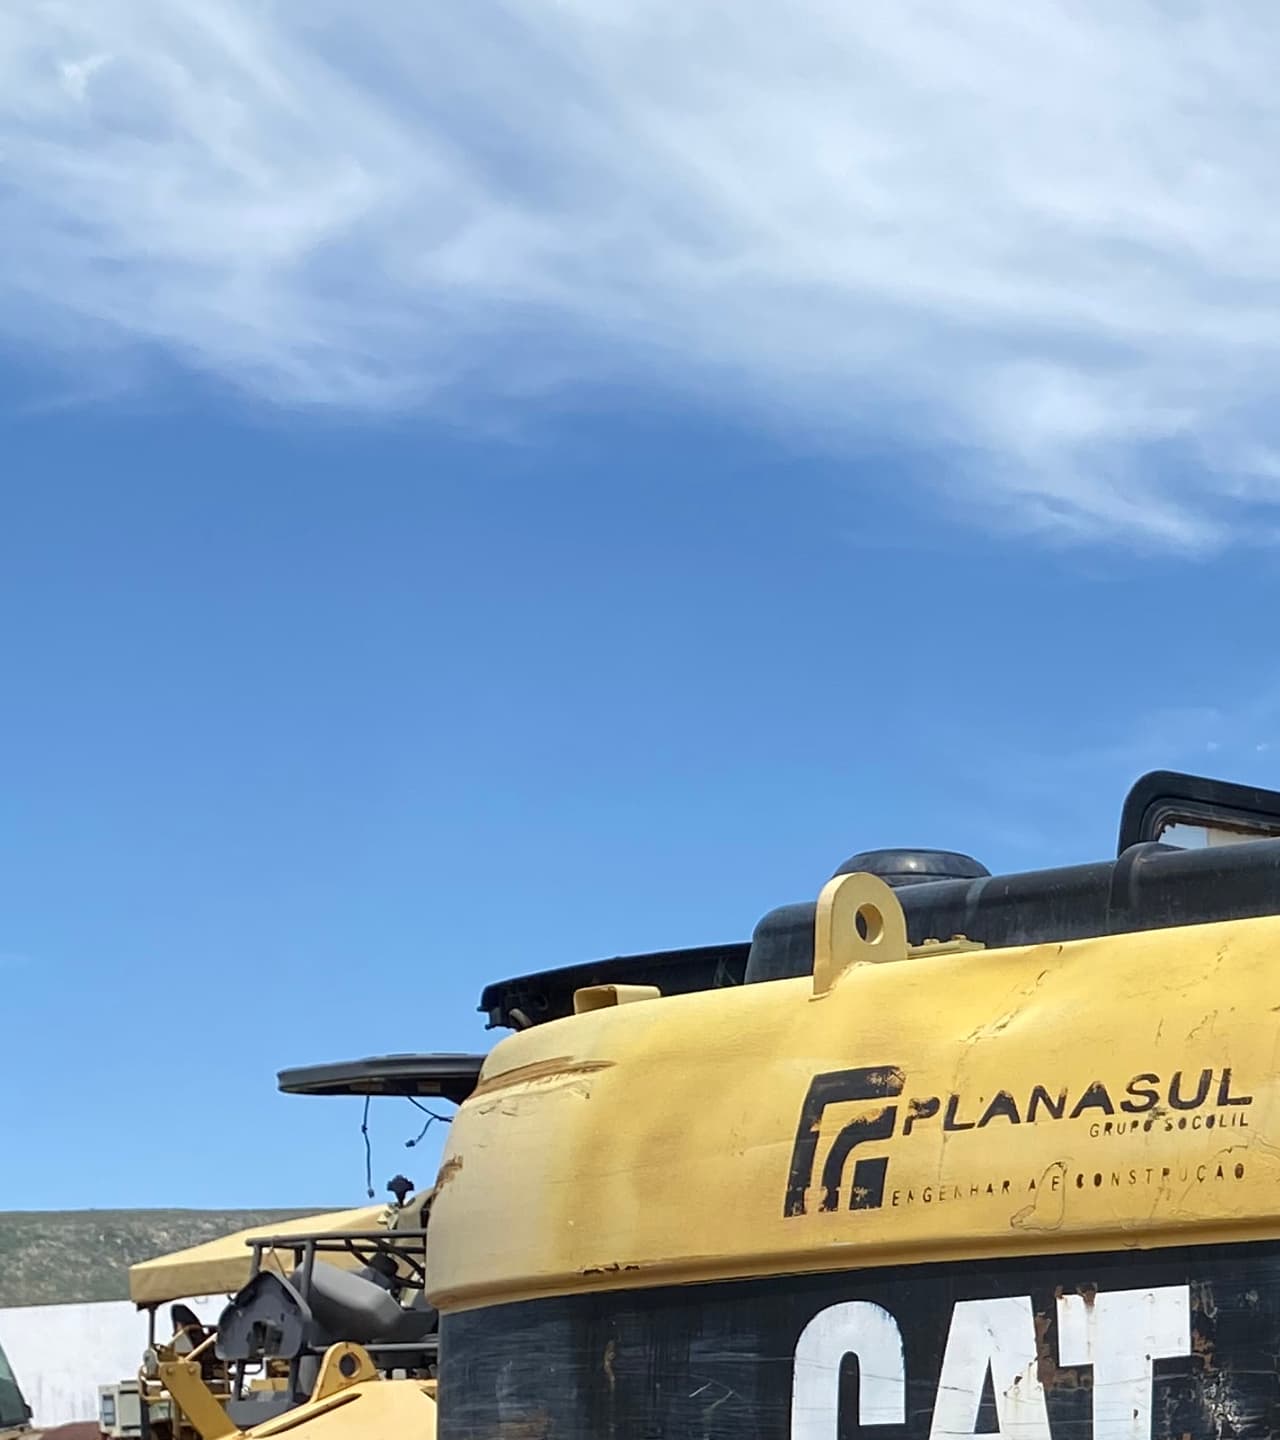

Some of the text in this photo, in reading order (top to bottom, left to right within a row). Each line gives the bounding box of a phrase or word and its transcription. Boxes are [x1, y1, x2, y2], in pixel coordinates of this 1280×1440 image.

[902, 1068, 1253, 1135] PLANASUL
[1089, 1112, 1249, 1138] GRUPO SOCOLIL
